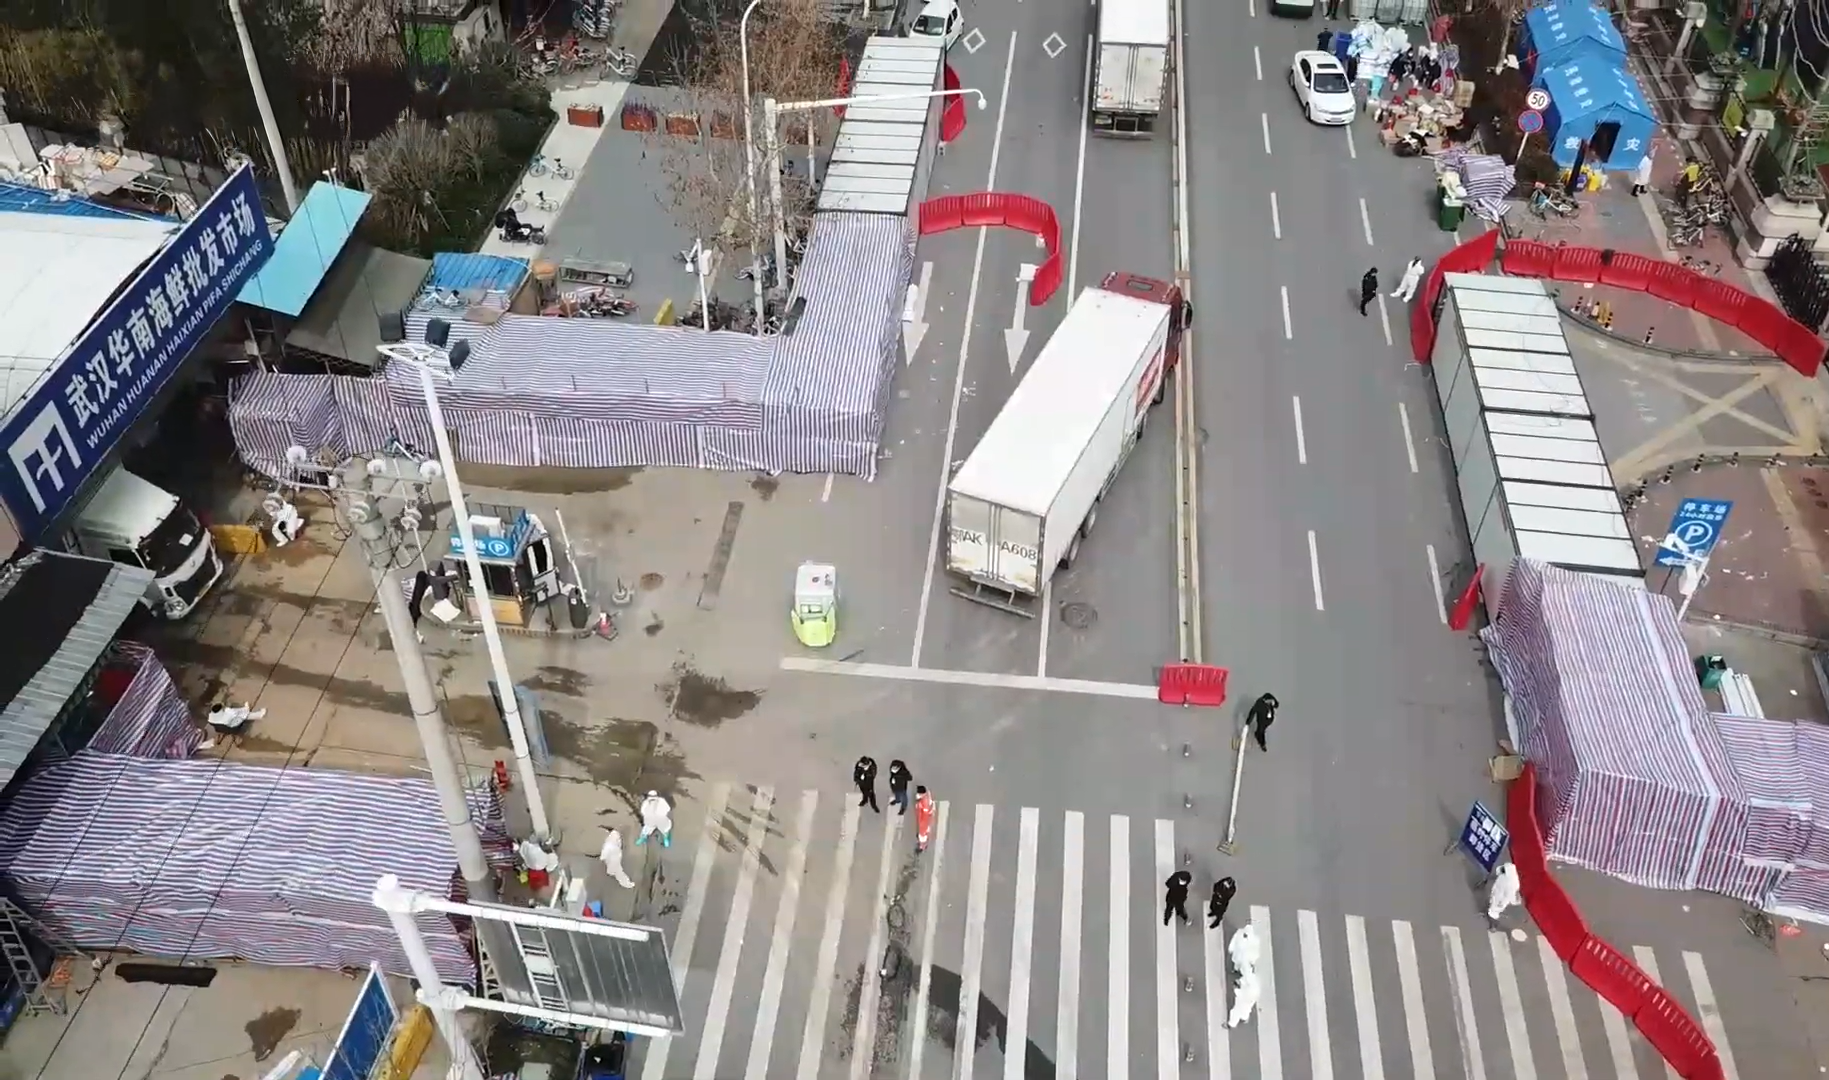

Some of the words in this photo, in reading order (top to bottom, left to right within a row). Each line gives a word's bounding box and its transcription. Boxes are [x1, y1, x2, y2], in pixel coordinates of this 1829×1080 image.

[1531, 93, 1545, 107] 50
[65, 190, 256, 429] 武汉华南海鲜批发市场
[86, 400, 128, 449] WUHAN
[127, 351, 168, 402] HUANAN
[166, 308, 204, 357] HAIXIAN
[202, 286, 223, 315] PIFA
[221, 239, 263, 292] SHICHANG
[1684, 525, 1704, 542] P
[1001, 541, 1037, 561] A608
